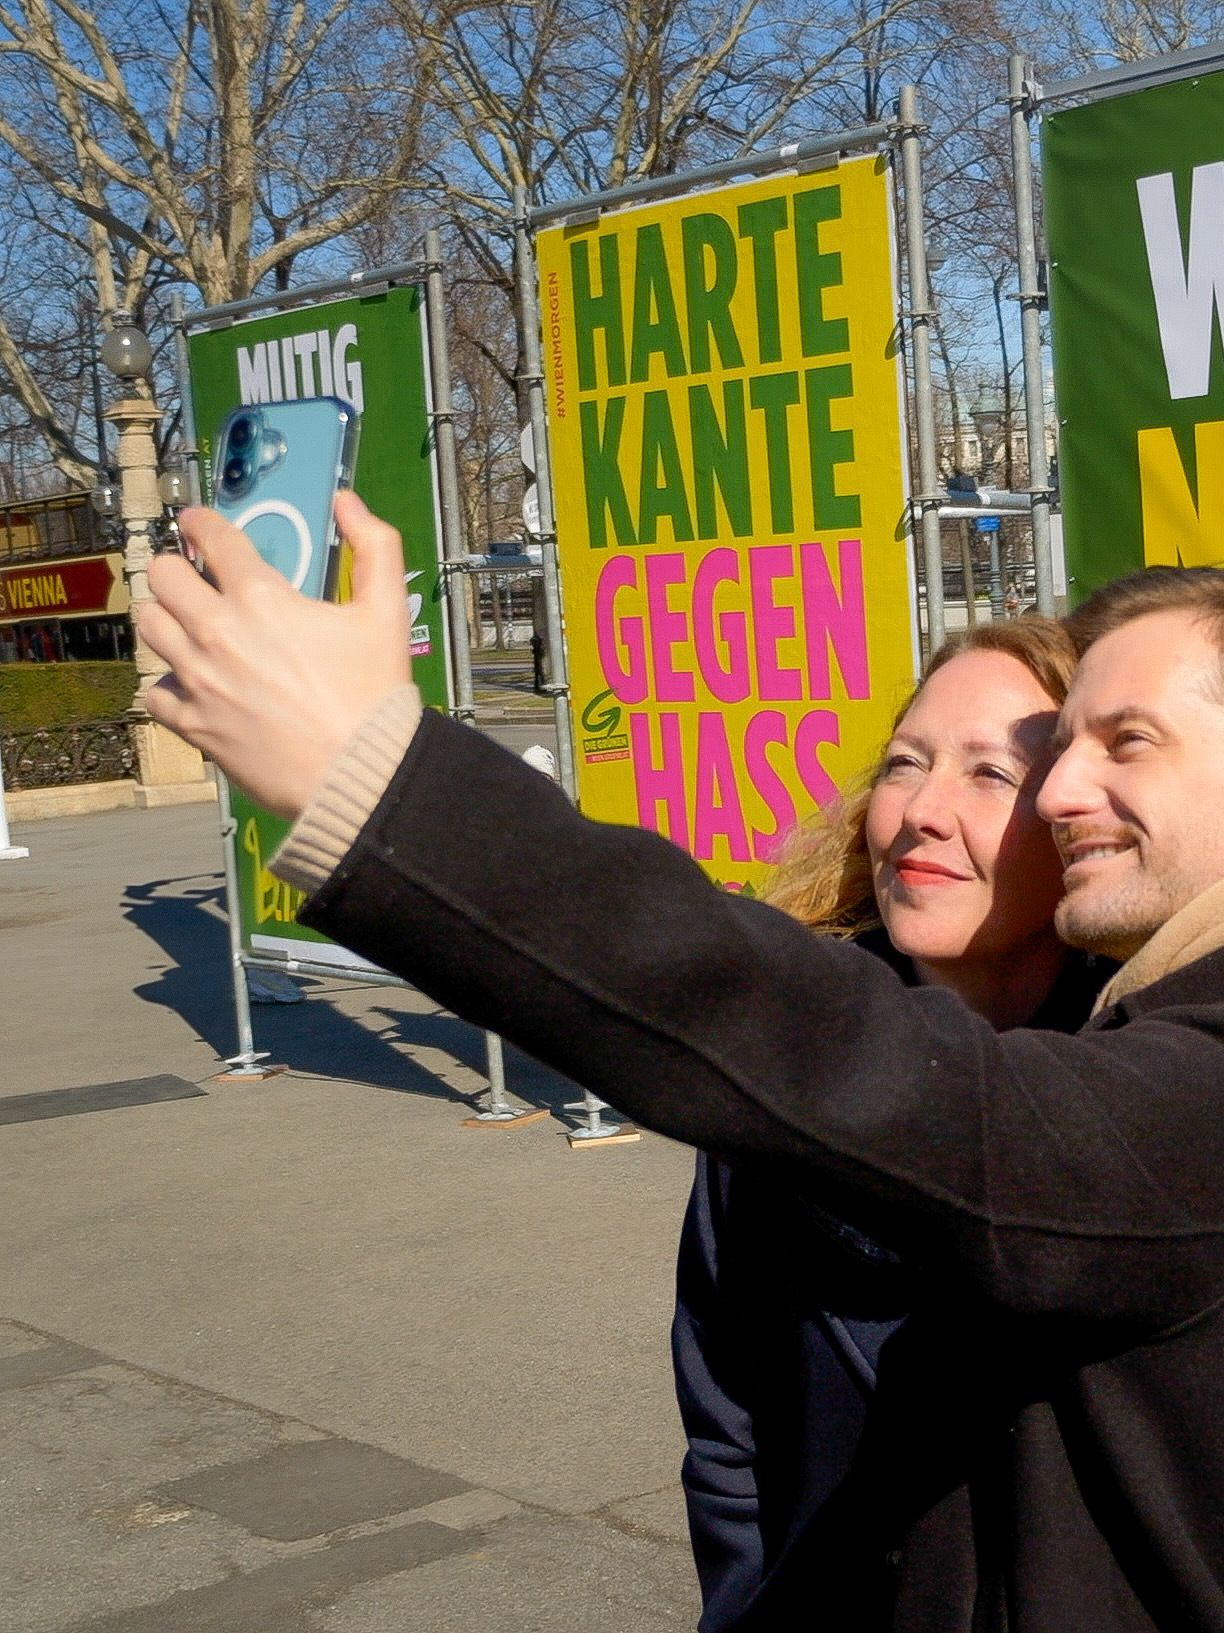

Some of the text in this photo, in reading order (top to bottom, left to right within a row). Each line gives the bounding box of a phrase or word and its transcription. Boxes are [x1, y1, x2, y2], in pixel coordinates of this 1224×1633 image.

[548, 272, 566, 419] #WIENMORGEN
[569, 184, 849, 392] HARTE
[236, 323, 365, 413] MUTIG
[578, 363, 863, 550] KANTE
[7, 574, 68, 610] VIENNA
[594, 539, 871, 705] GEGEN
[629, 708, 846, 865] HASS
